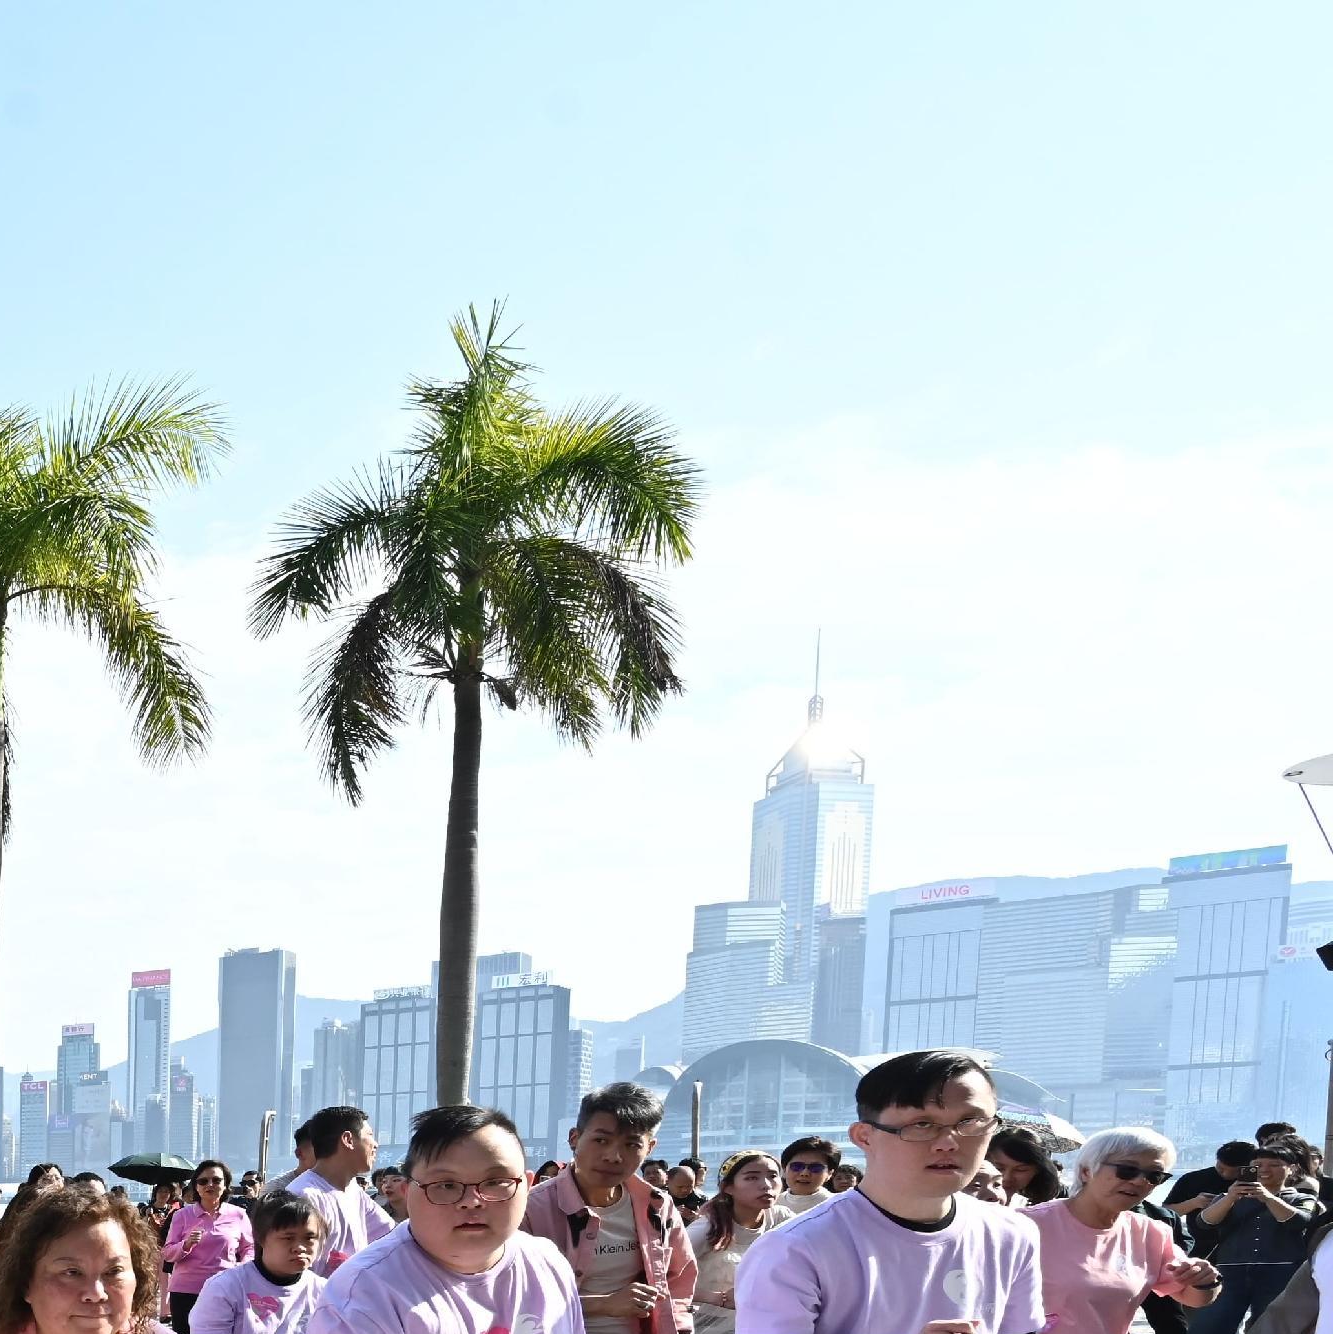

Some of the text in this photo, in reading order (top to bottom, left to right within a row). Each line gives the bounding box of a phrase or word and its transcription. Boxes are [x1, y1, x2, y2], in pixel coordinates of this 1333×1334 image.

[920, 884, 971, 900] LIVING
[518, 971, 548, 986] 宏利
[599, 1243, 624, 1256] Klein
